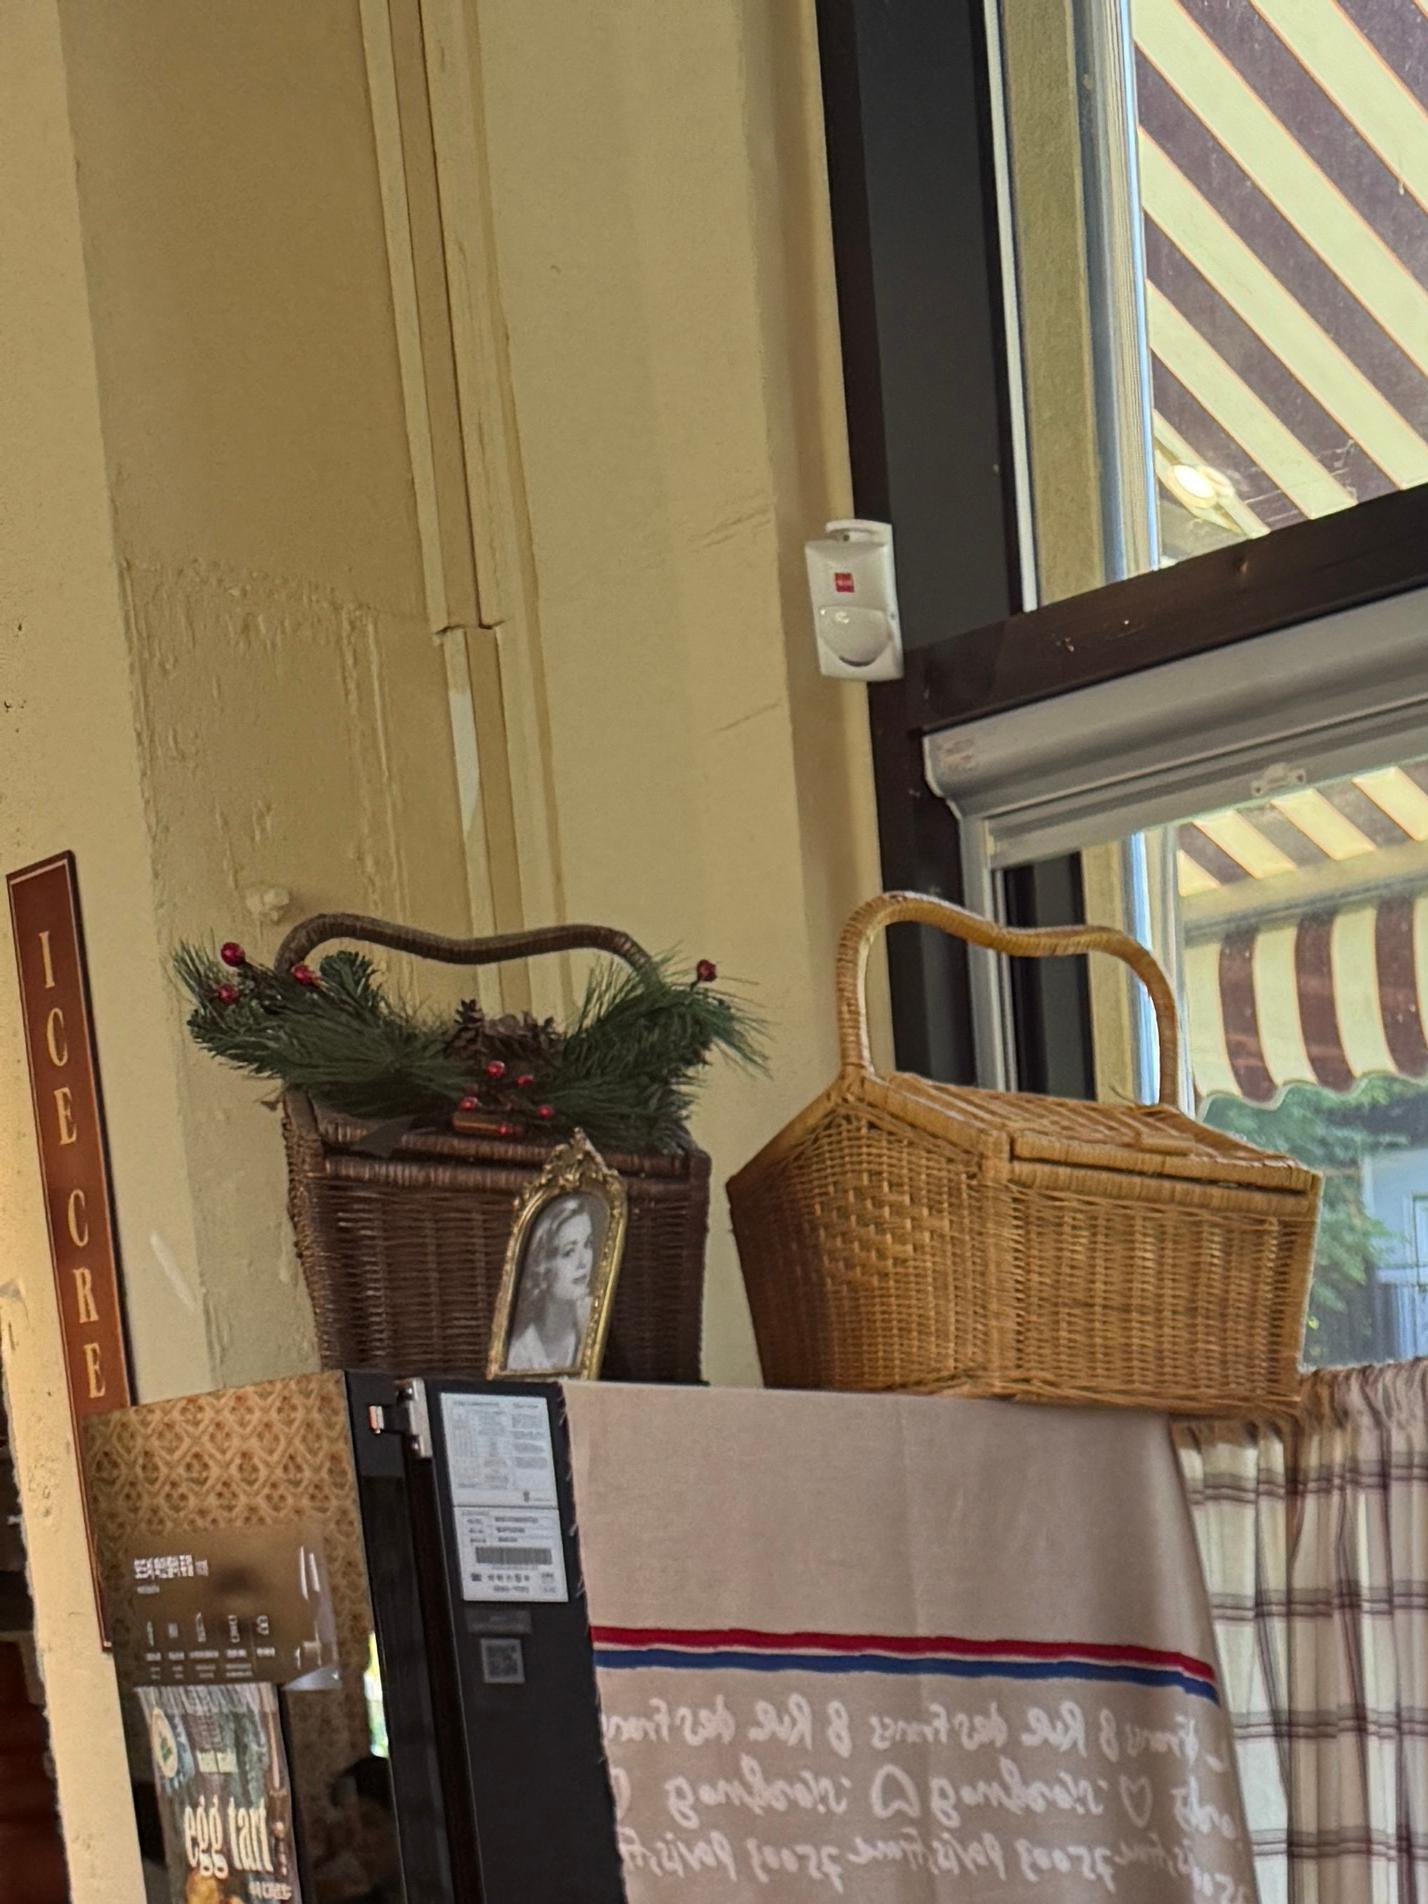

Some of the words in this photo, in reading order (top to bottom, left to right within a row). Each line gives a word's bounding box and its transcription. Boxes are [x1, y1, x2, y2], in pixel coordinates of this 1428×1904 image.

[38, 931, 77, 1146] ICE
[183, 1794, 229, 1880] egg
[228, 1796, 274, 1873] tart
